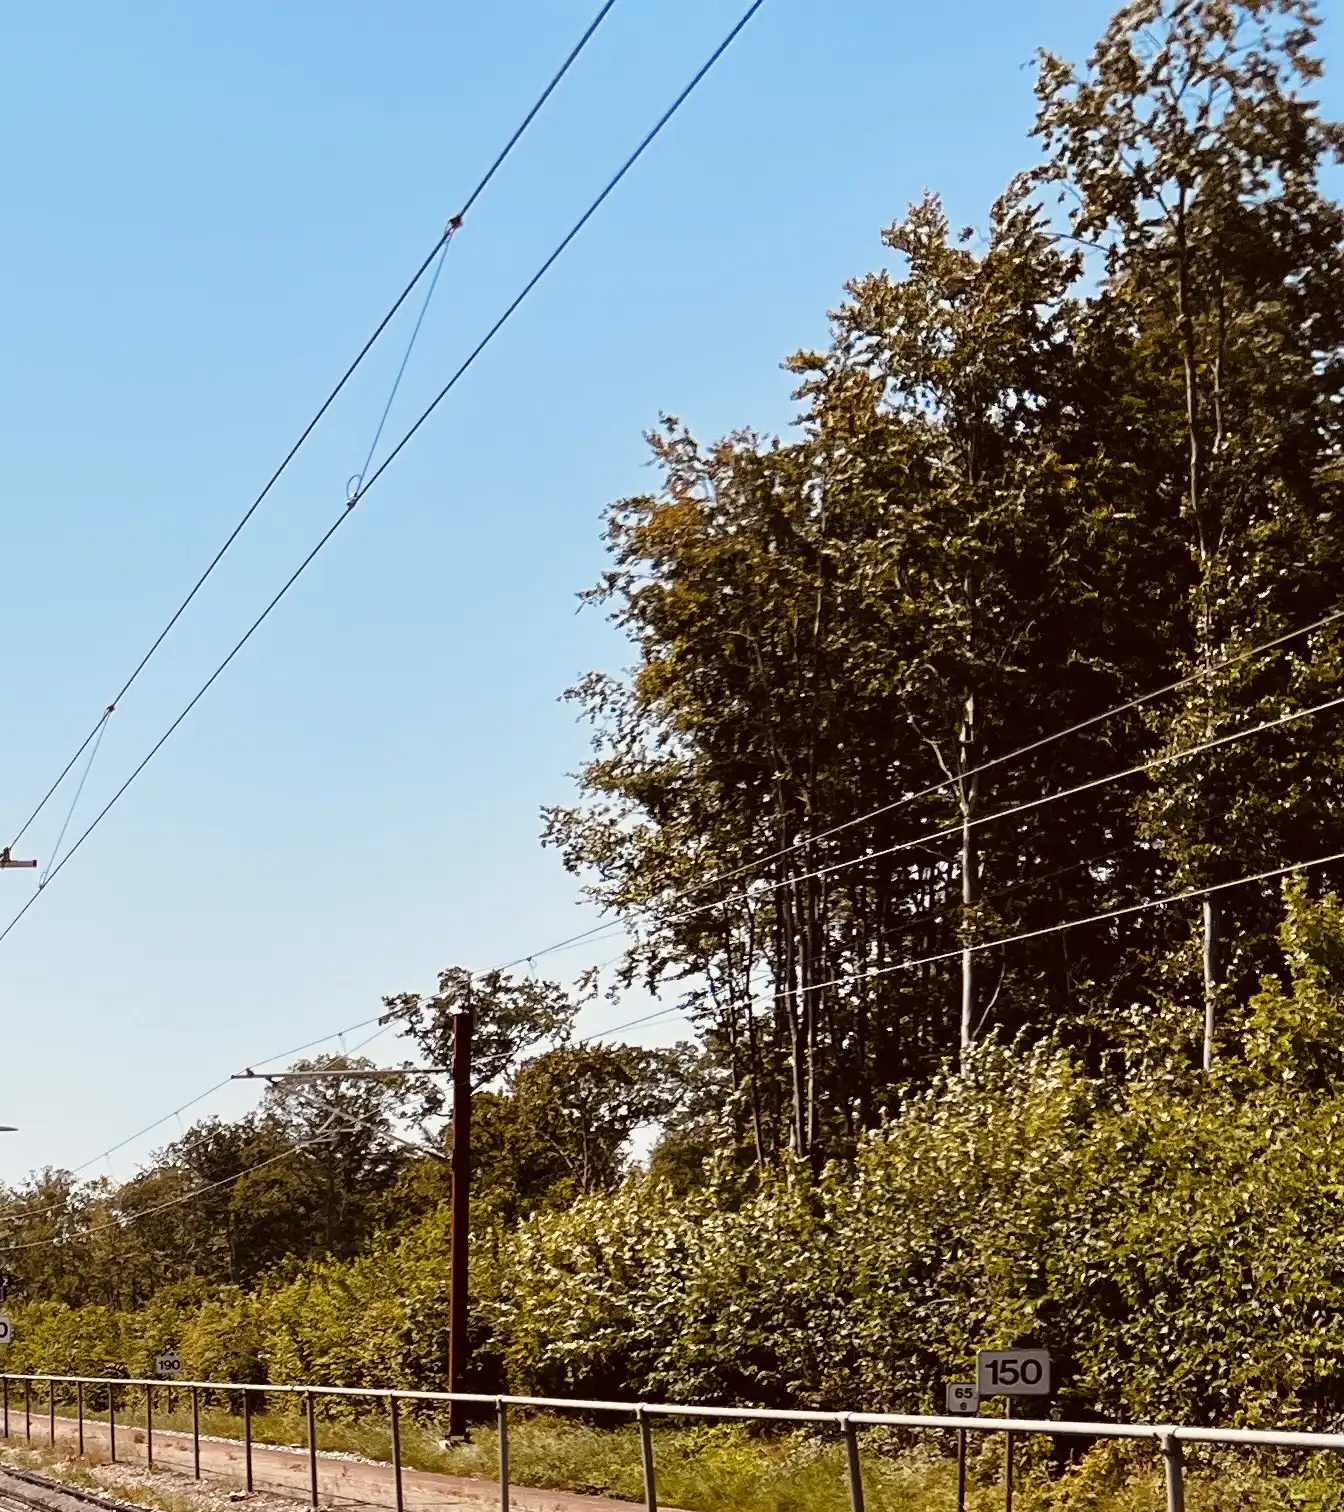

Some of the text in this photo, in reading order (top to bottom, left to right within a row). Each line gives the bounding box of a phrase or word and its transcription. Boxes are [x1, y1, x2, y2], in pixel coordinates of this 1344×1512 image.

[158, 1359, 181, 1370] 190
[984, 1358, 1043, 1386] 150
[955, 1387, 973, 1399] 65
